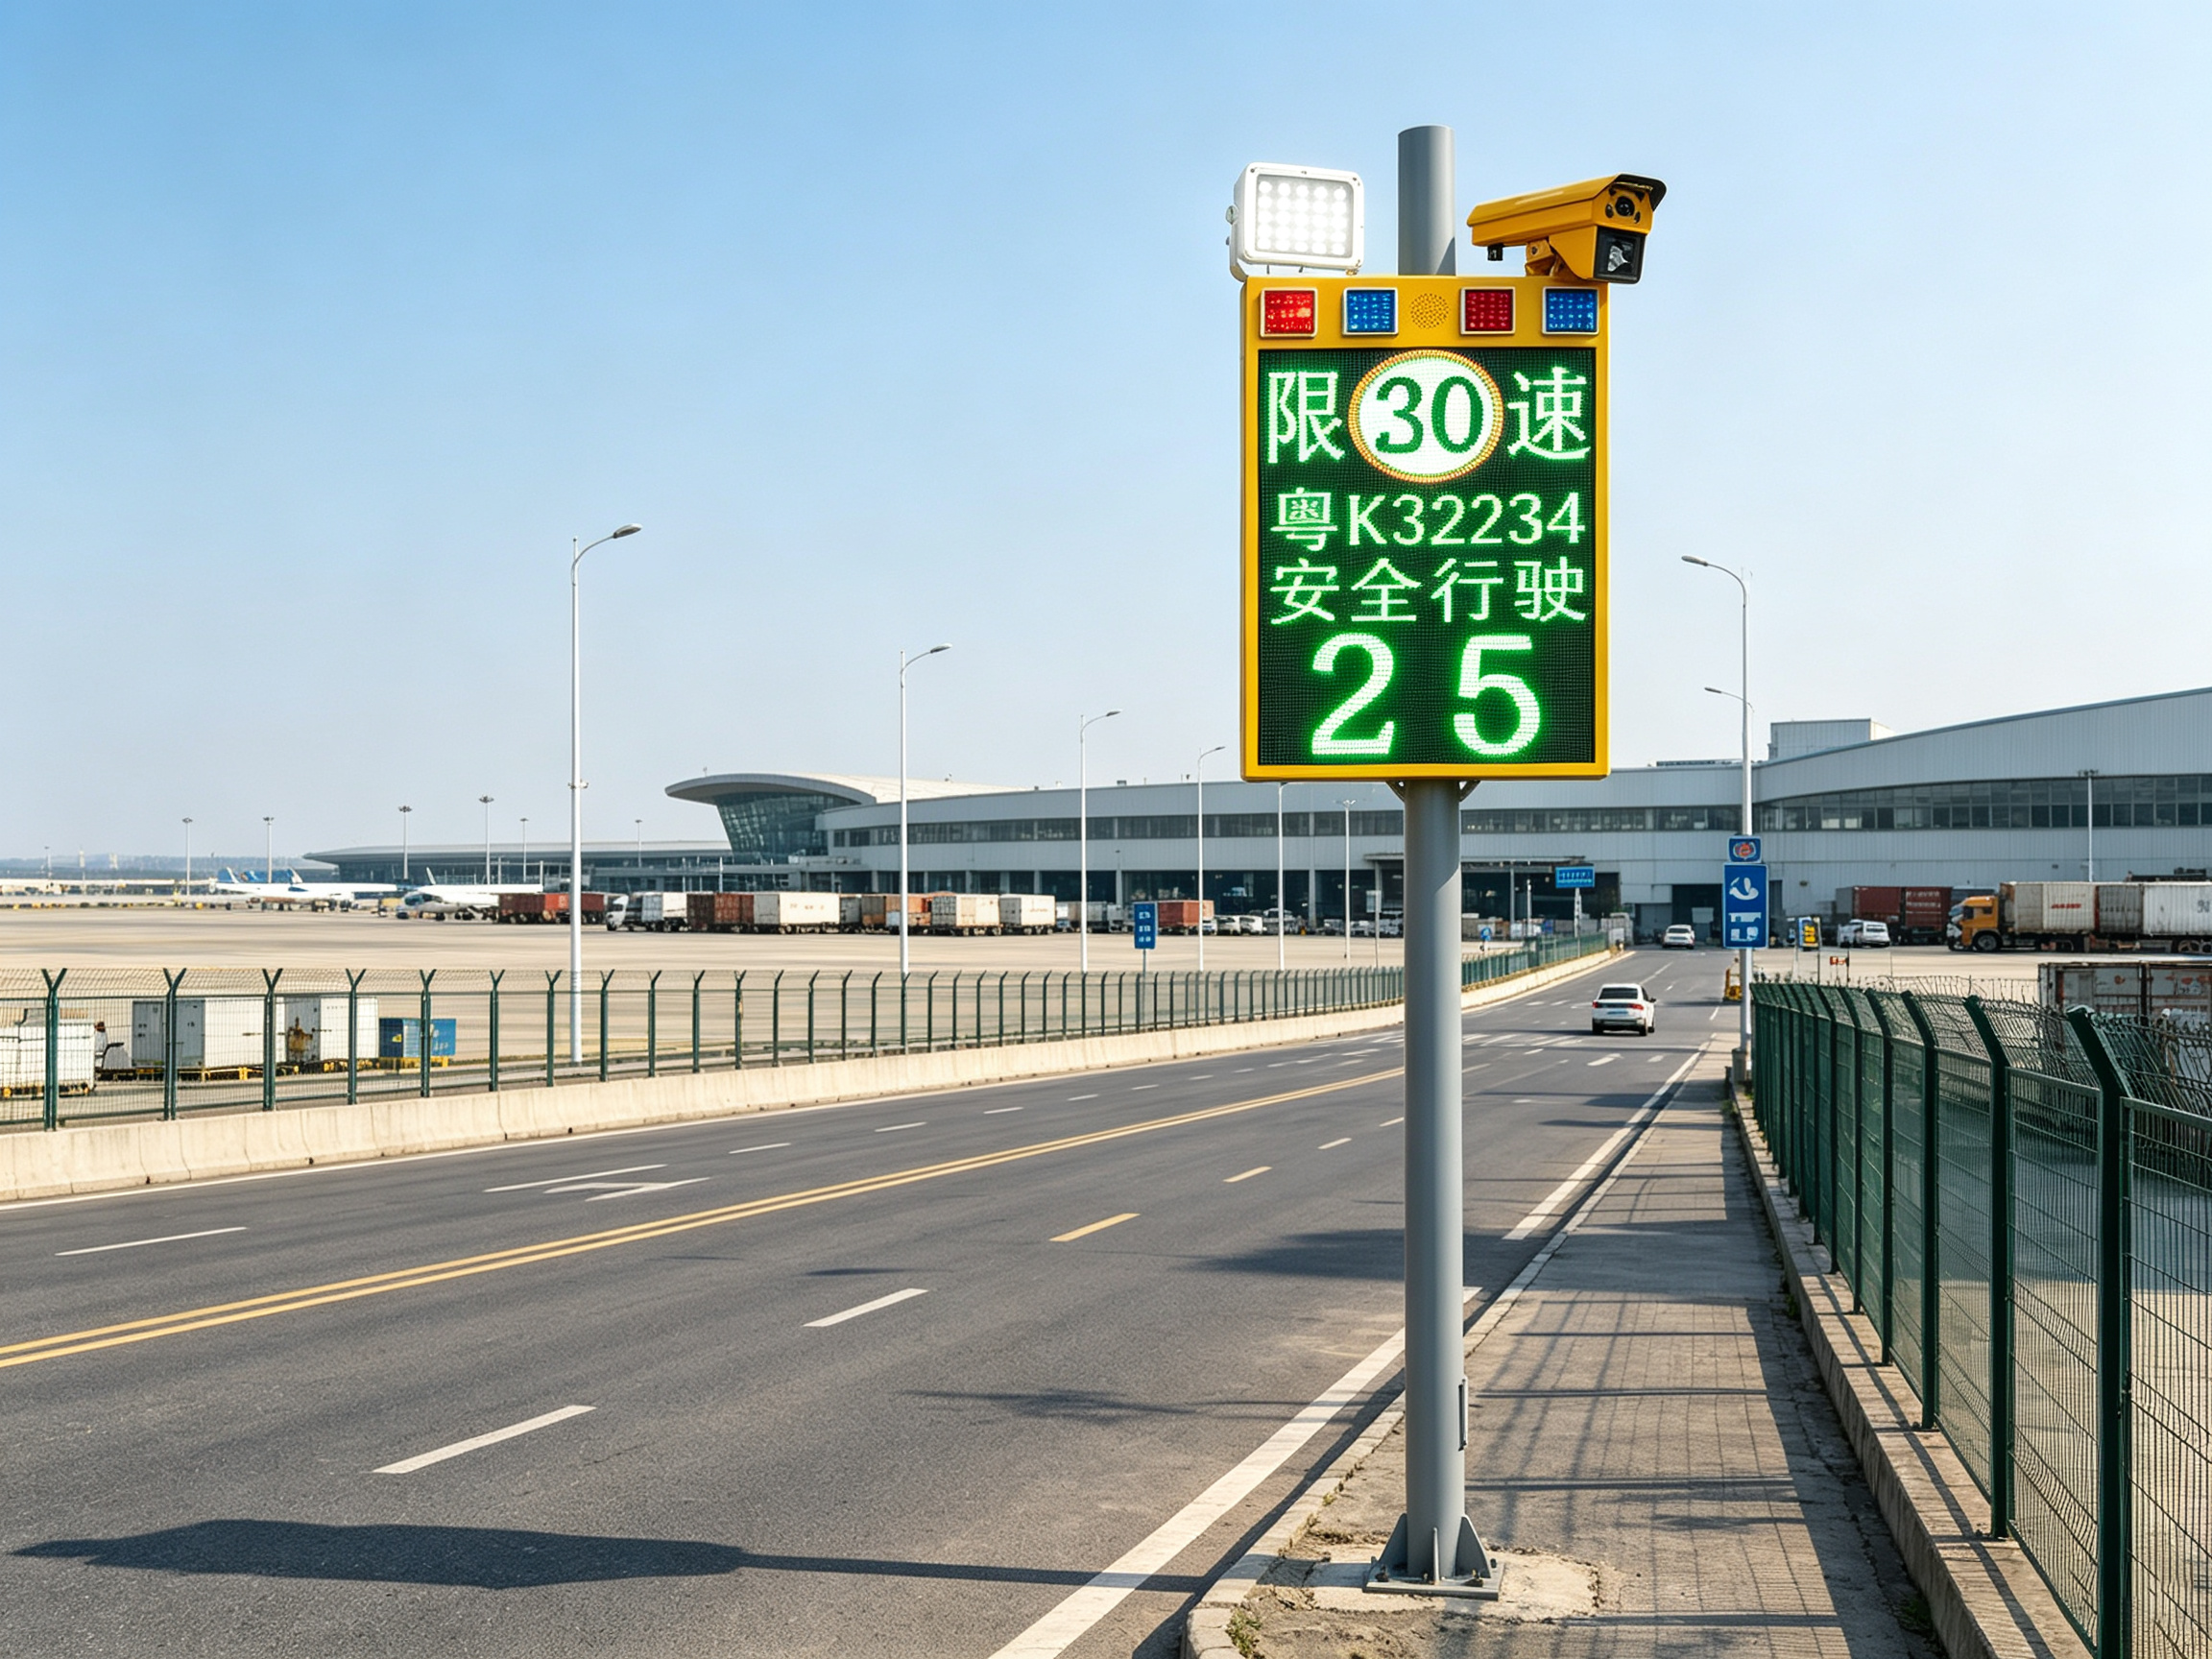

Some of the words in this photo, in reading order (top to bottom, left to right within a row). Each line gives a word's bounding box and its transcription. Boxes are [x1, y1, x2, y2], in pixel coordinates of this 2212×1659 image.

[1266, 370, 1345, 464] 限
[1372, 371, 1484, 455] 30
[1506, 366, 1592, 461] 速
[1269, 555, 1587, 625] 安全行驶
